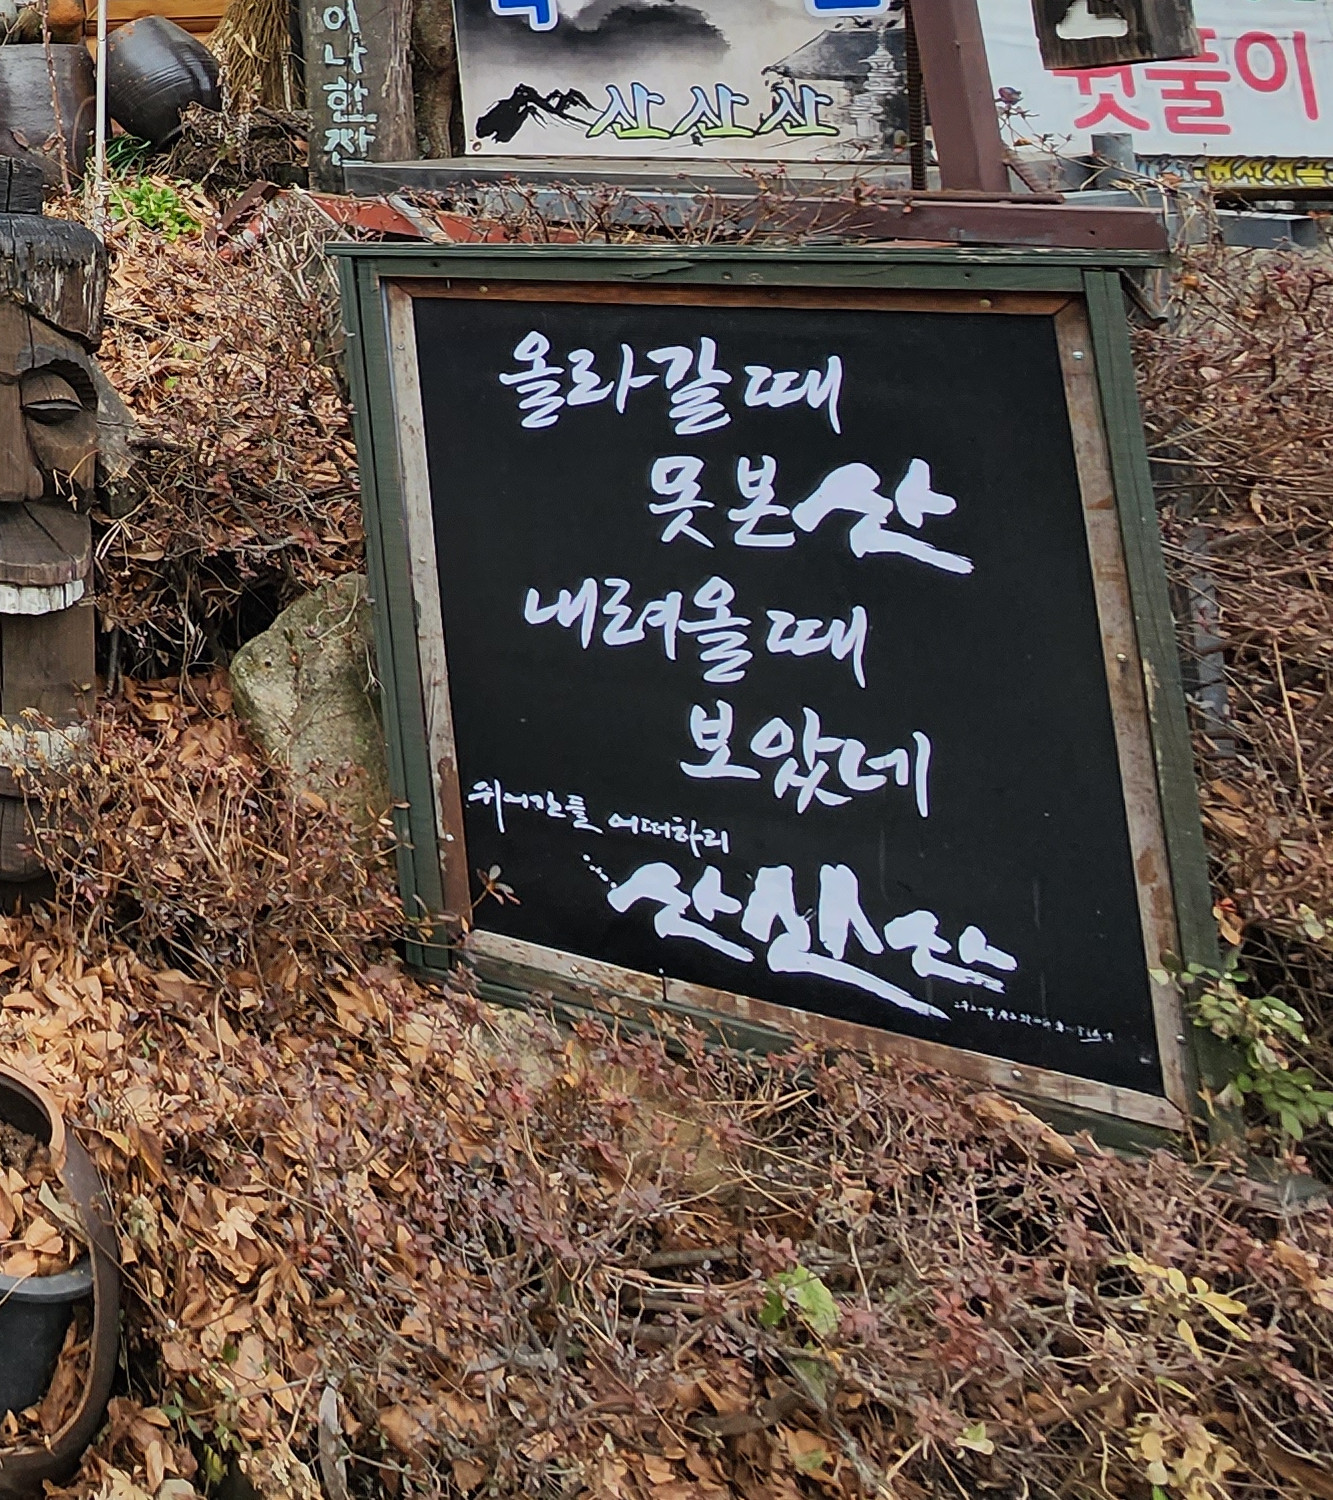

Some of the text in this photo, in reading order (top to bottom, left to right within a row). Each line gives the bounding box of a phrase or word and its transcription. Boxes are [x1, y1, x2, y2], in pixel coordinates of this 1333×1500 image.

[498, 330, 844, 436] 올라갈 때
[523, 574, 868, 689] 내려올 때
[608, 812, 730, 858] 어떠하리
